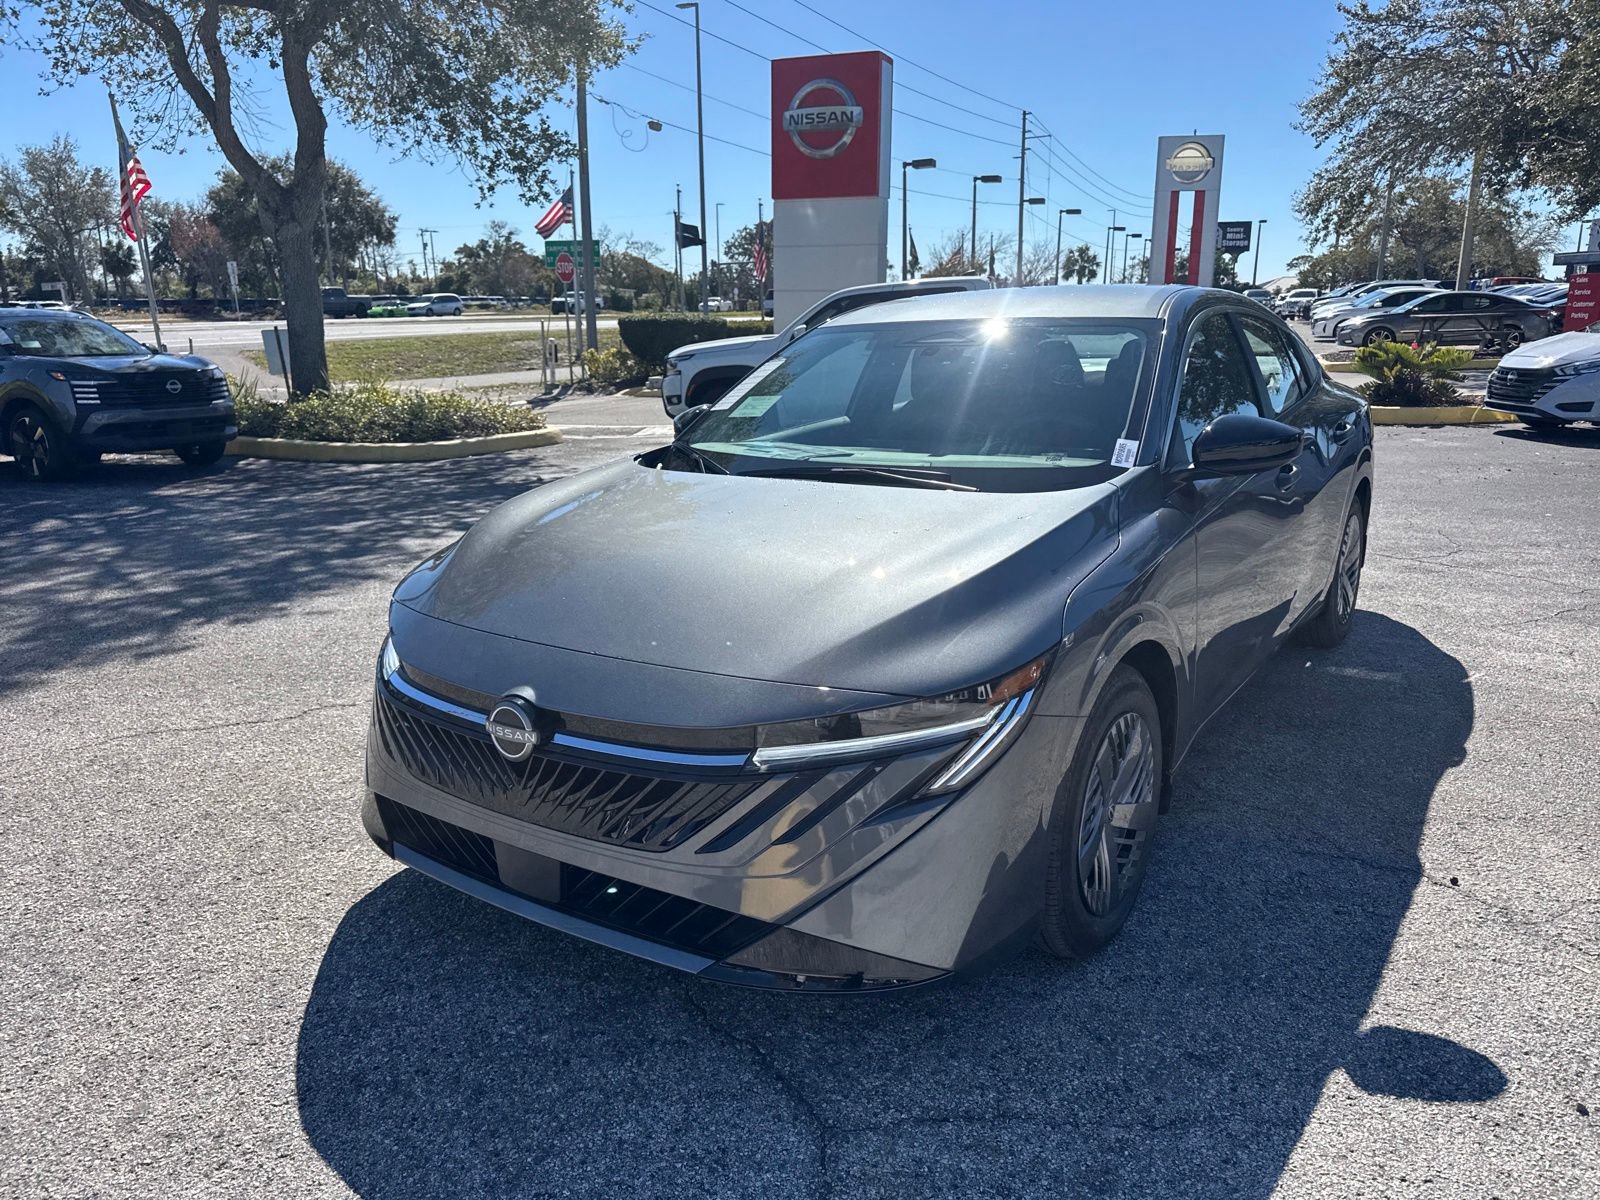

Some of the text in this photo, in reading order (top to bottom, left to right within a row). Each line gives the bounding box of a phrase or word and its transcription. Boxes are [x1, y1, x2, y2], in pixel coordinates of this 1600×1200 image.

[788, 110, 854, 127] NISSAN
[557, 262, 573, 273] STOP
[485, 721, 535, 743] NISSAN
